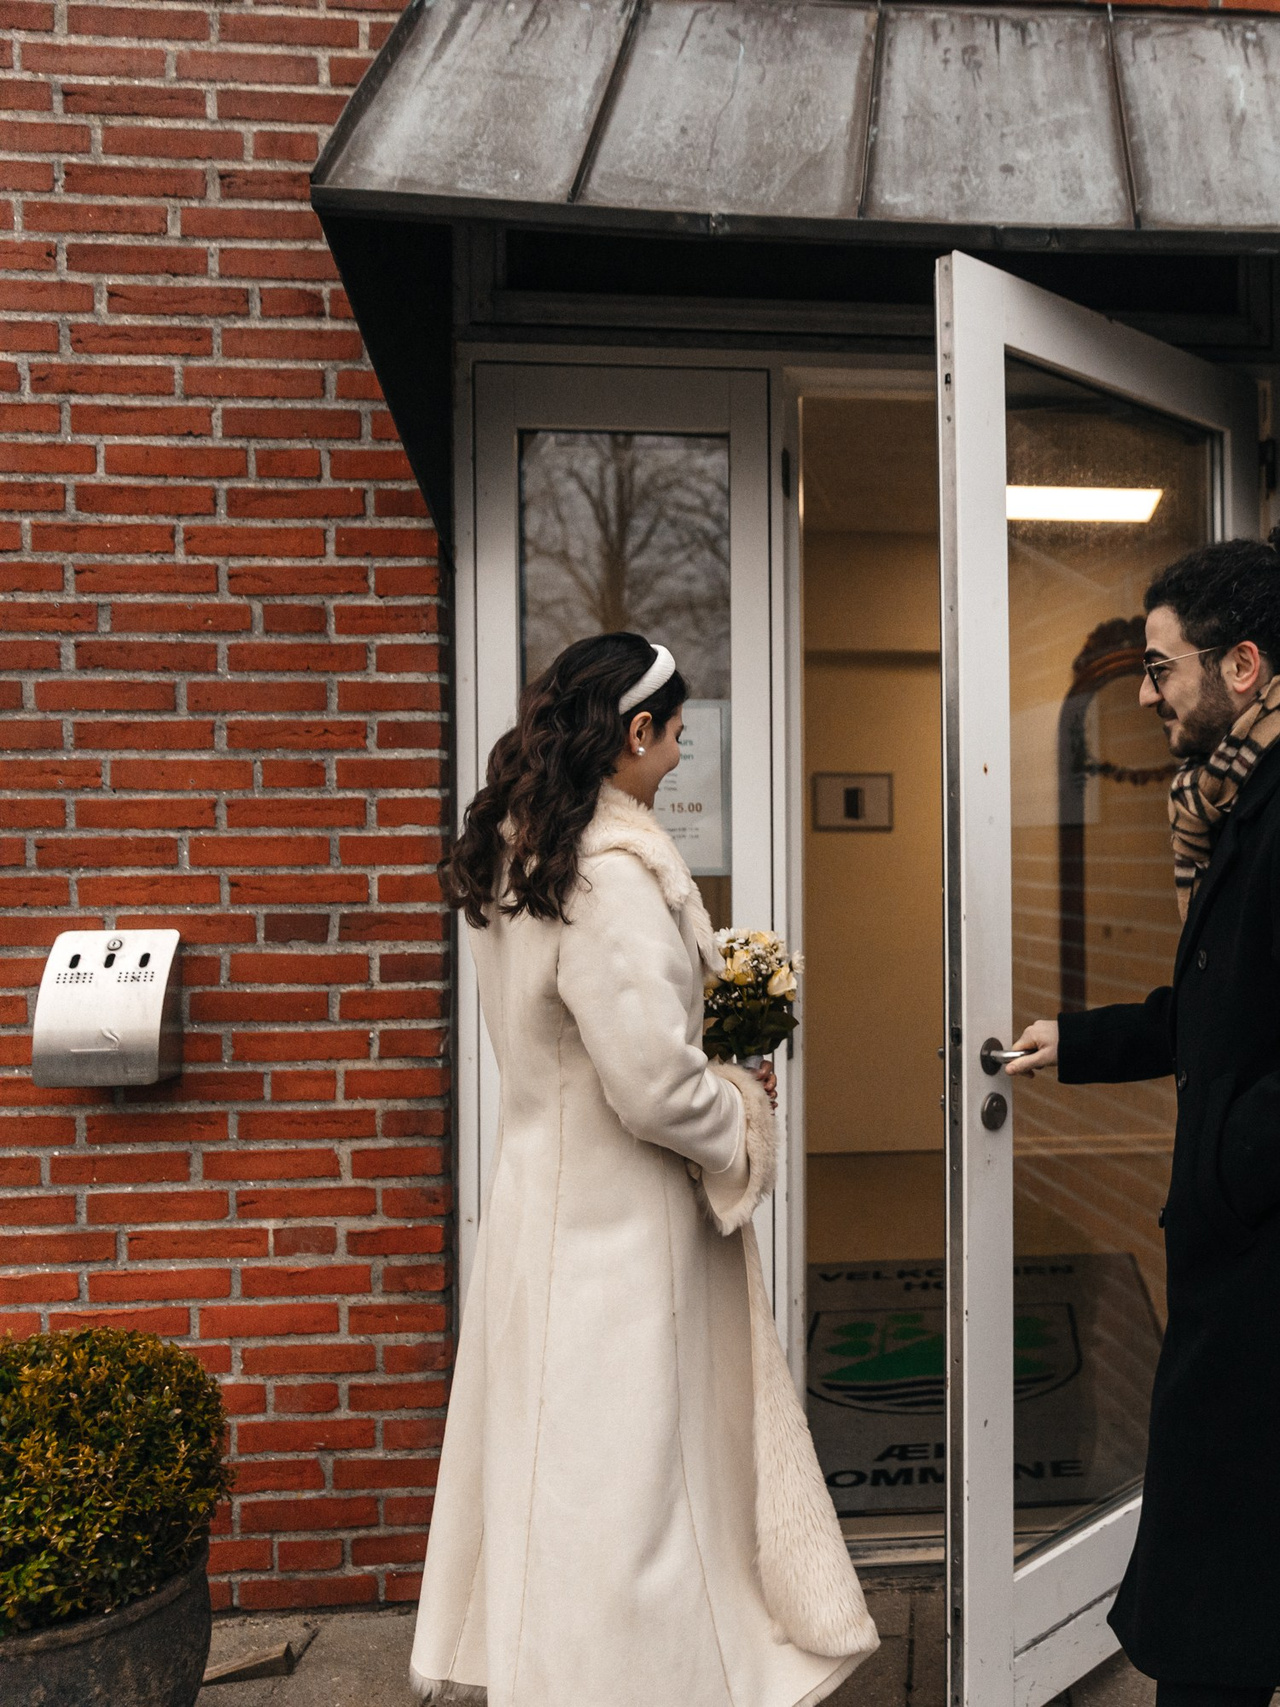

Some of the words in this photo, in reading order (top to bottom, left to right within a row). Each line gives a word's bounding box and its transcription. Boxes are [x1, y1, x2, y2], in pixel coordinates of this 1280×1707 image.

[670, 802, 703, 813] 15.00
[818, 1265, 1073, 1282] VELKOEN
[826, 1460, 1085, 1488] OMMNE
